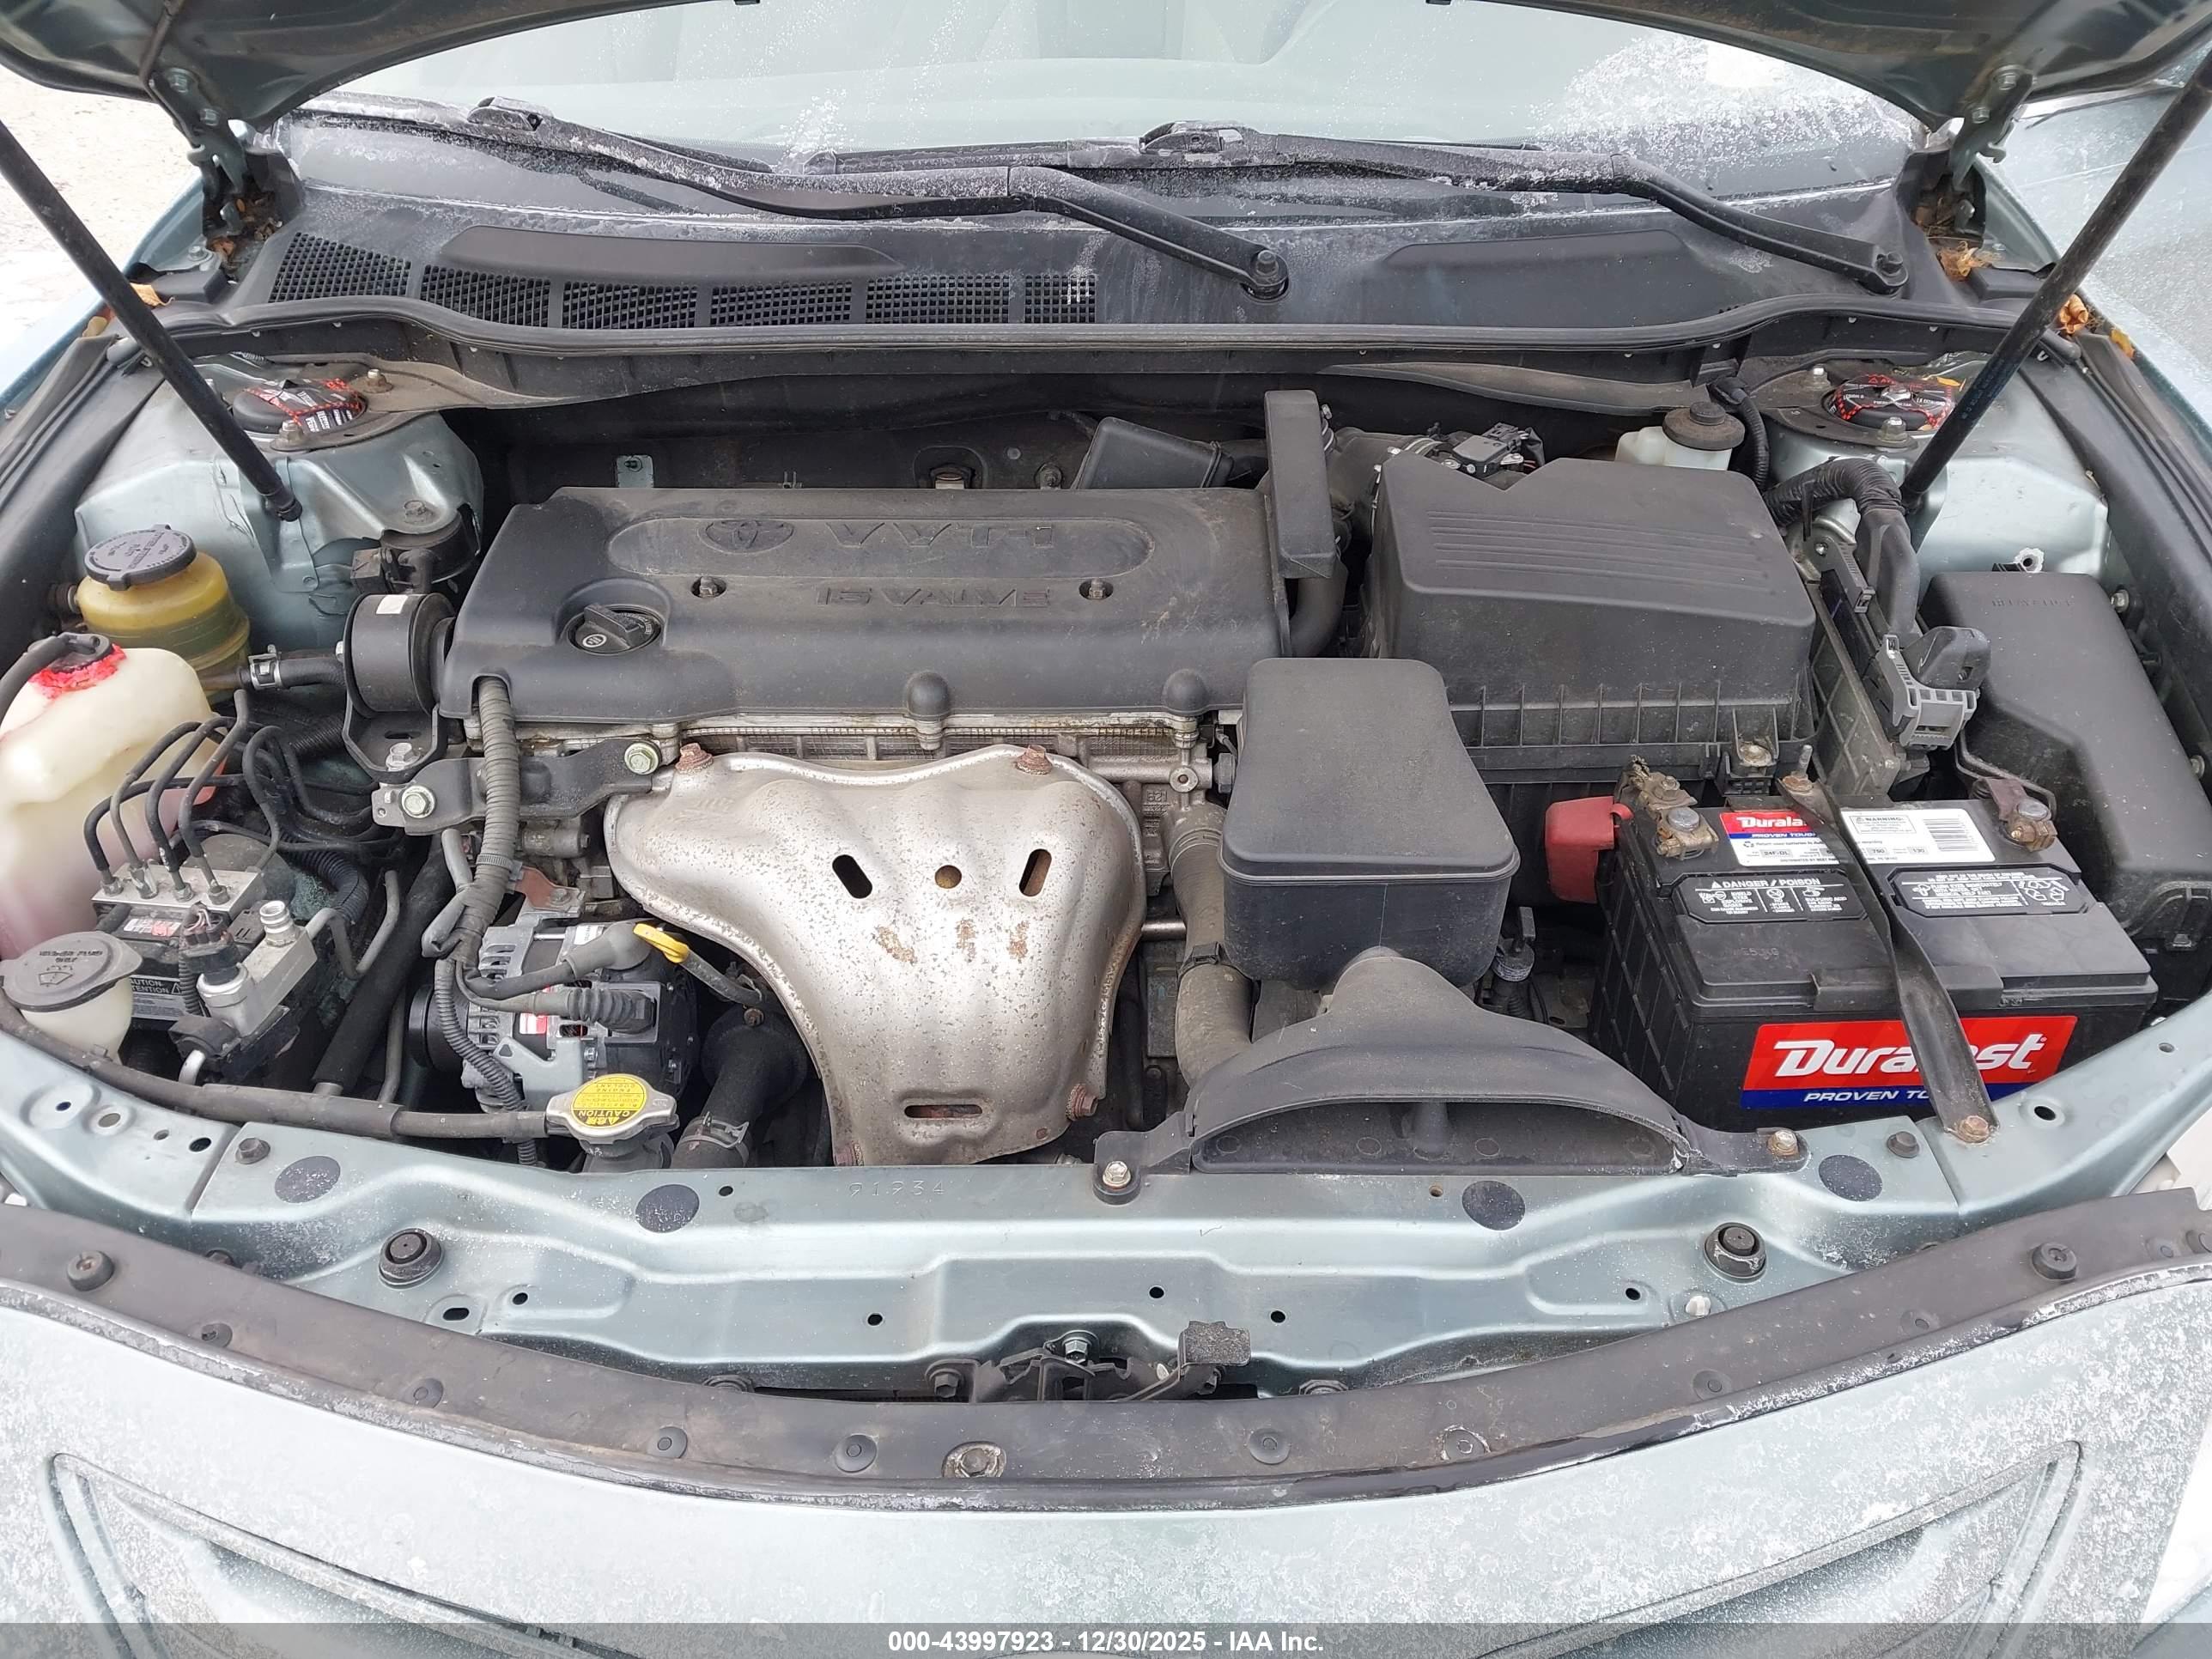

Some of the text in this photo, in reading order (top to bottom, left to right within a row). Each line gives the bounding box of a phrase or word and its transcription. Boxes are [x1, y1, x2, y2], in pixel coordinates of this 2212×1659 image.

[1736, 817, 1808, 828] Durala
[1723, 879, 1769, 888] DANGER
[131, 985, 169, 994] TENTION
[1773, 1033, 2045, 1077] Durast
[1803, 1091, 1899, 1102] PROVEN
